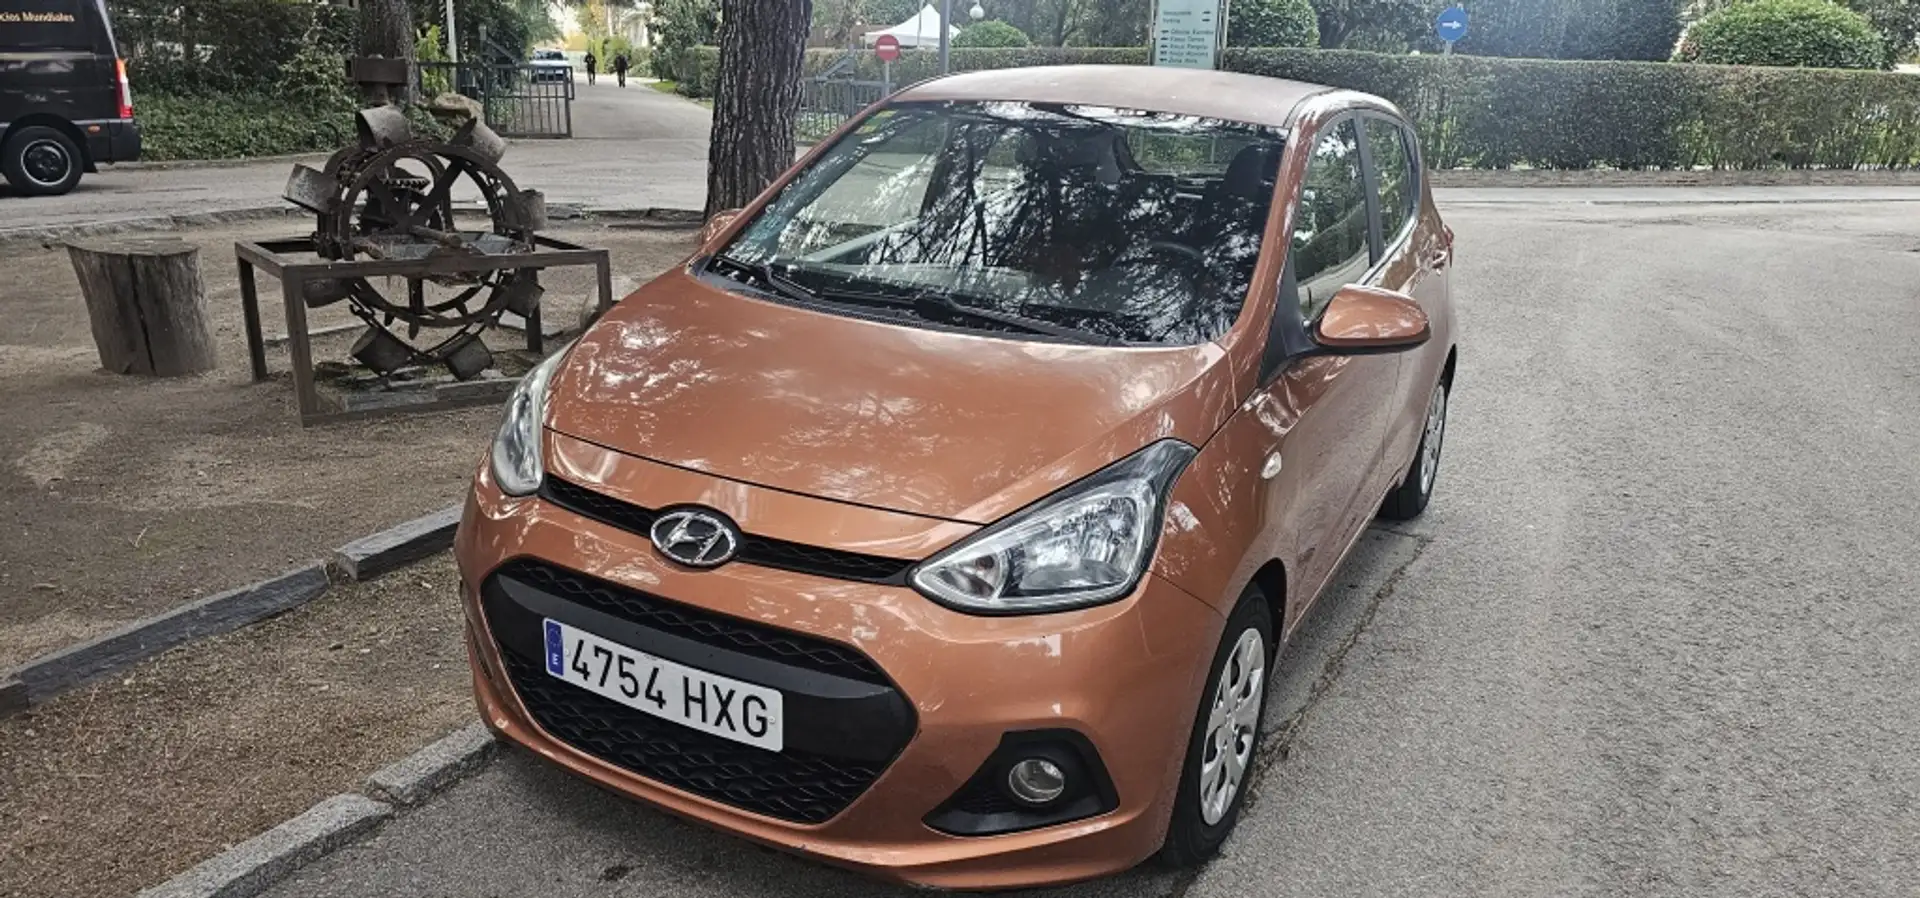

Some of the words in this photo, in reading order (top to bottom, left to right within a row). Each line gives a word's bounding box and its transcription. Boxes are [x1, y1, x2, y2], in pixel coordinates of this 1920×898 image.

[22, 11, 75, 22] Mundiales
[571, 639, 667, 710] 4754
[683, 675, 769, 738] HXG
